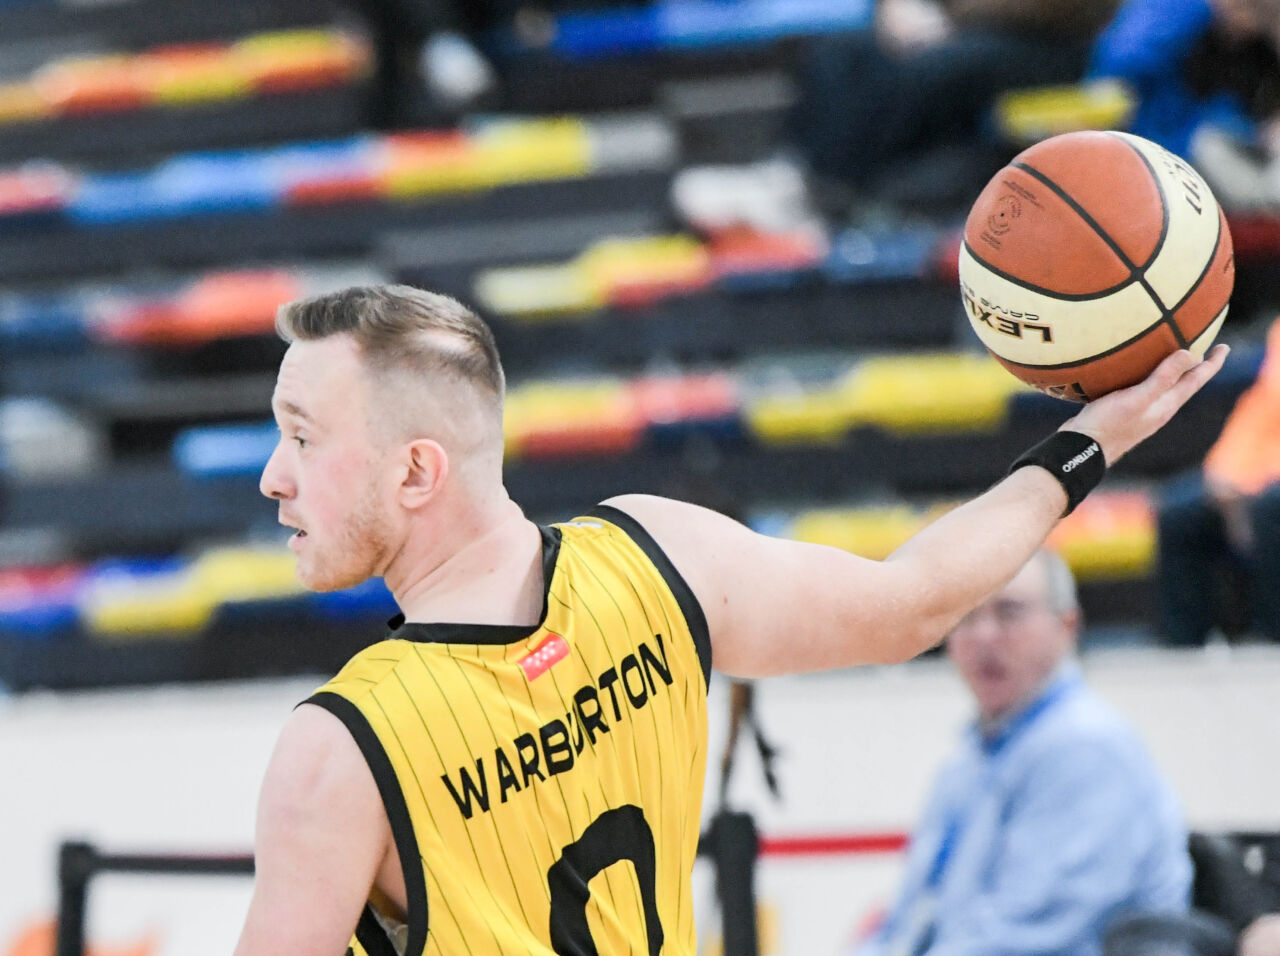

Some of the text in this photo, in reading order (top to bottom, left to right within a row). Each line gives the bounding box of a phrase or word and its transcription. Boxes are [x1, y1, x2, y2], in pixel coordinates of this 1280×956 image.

[964, 292, 1053, 343] LEXU
[1062, 442, 1099, 472] ARTENGO
[441, 633, 674, 819] WARBURTON
